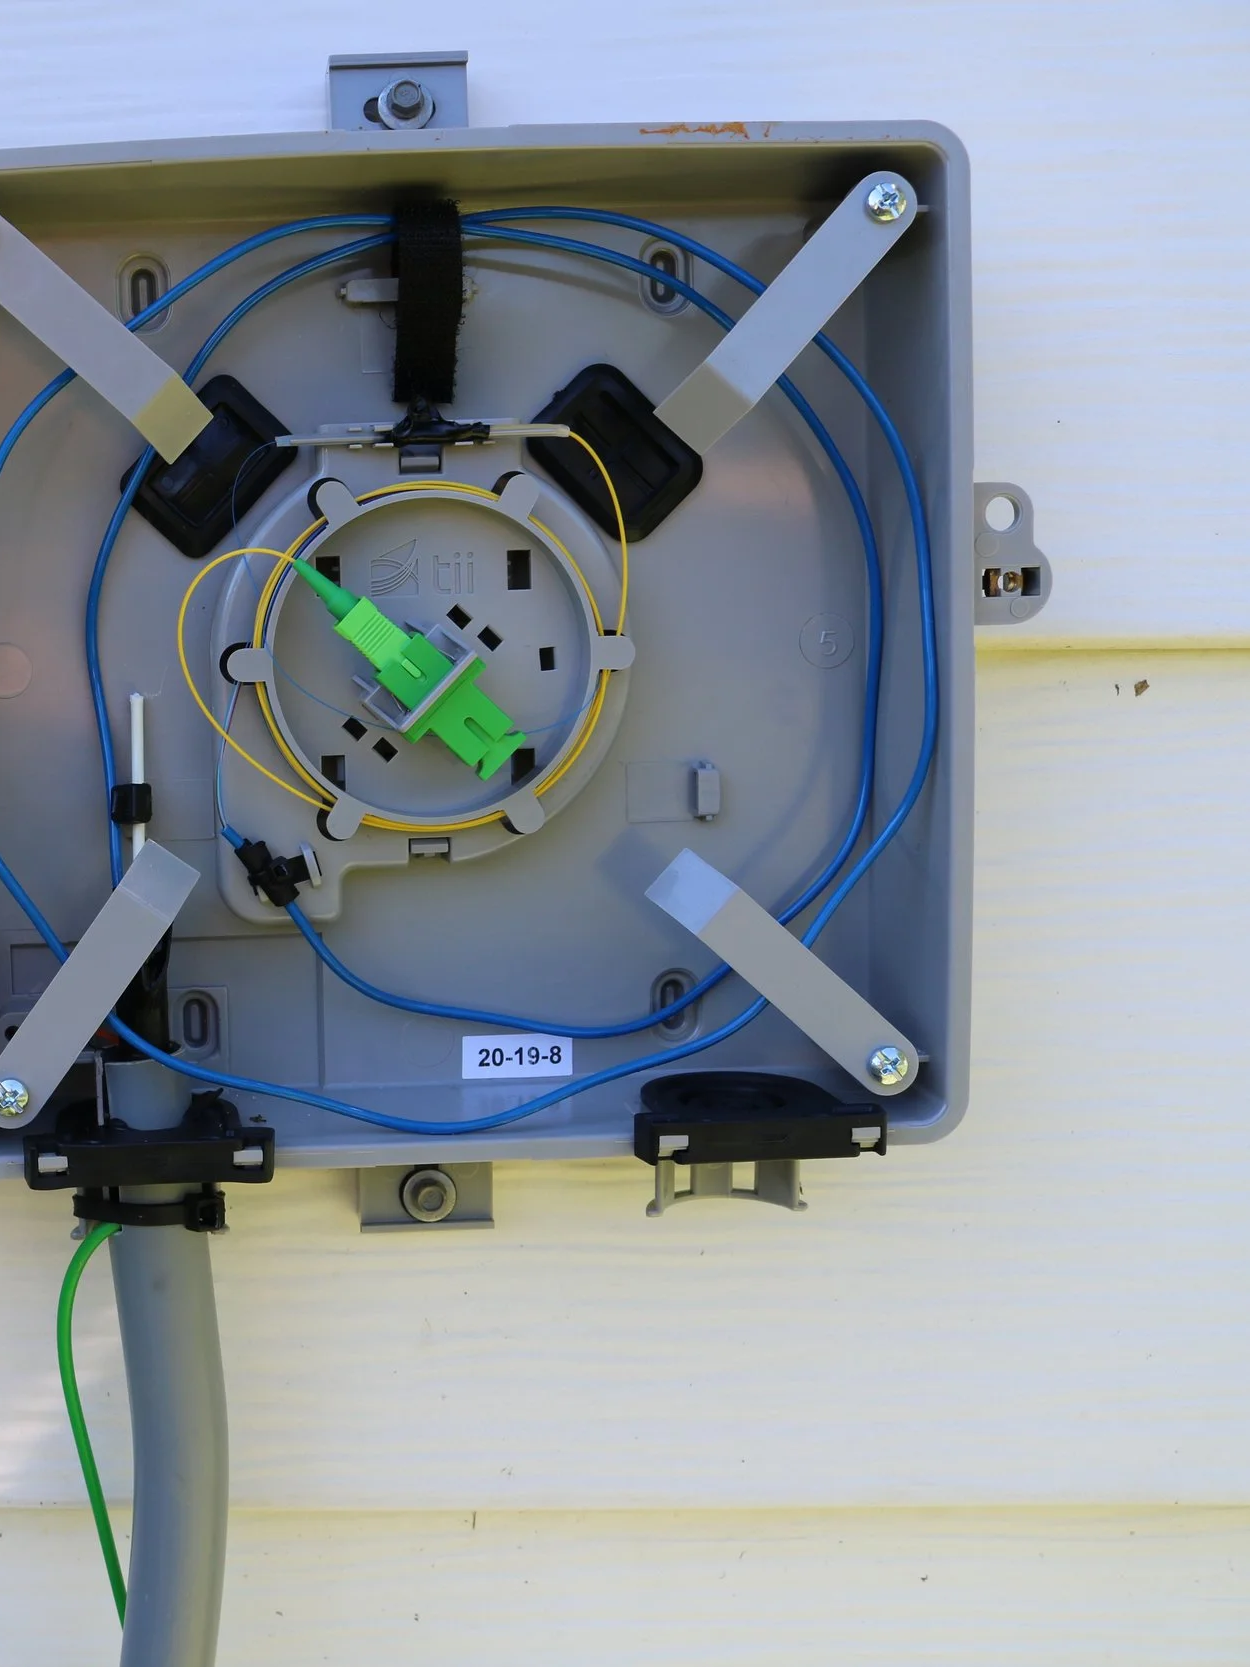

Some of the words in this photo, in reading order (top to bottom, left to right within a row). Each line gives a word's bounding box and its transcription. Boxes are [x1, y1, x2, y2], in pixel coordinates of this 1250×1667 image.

[432, 551, 474, 594] tii
[818, 629, 838, 656] 5
[477, 1045, 563, 1067] 20-19-8
